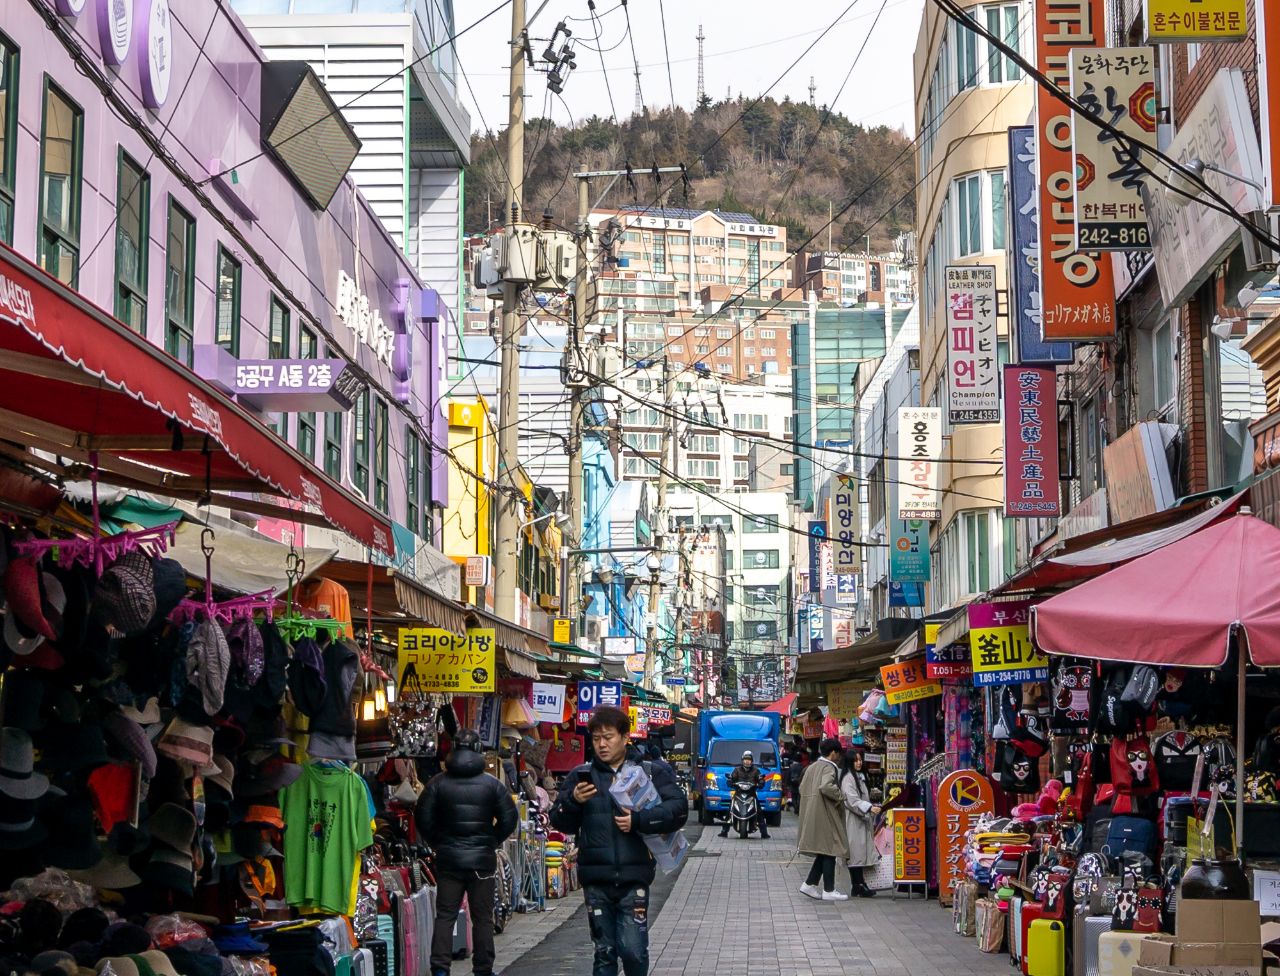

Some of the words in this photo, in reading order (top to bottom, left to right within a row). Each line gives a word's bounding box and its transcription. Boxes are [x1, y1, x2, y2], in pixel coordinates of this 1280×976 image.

[1153, 12, 1241, 32] 혼수이불전문
[1078, 54, 1150, 76] 은화주단
[949, 281, 975, 289] LEATHER
[1046, 303, 1111, 325] コリアメガネ店
[236, 365, 274, 389] 5공구
[278, 364, 304, 389] A동
[308, 364, 332, 388] 2층
[951, 391, 996, 399] Champion
[1018, 370, 1044, 499] 安東民藝土産品
[402, 635, 492, 653] 코리아가방
[407, 653, 487, 666] コリアカバン
[580, 686, 619, 706] 이불
[905, 816, 922, 876] 쌍방울
